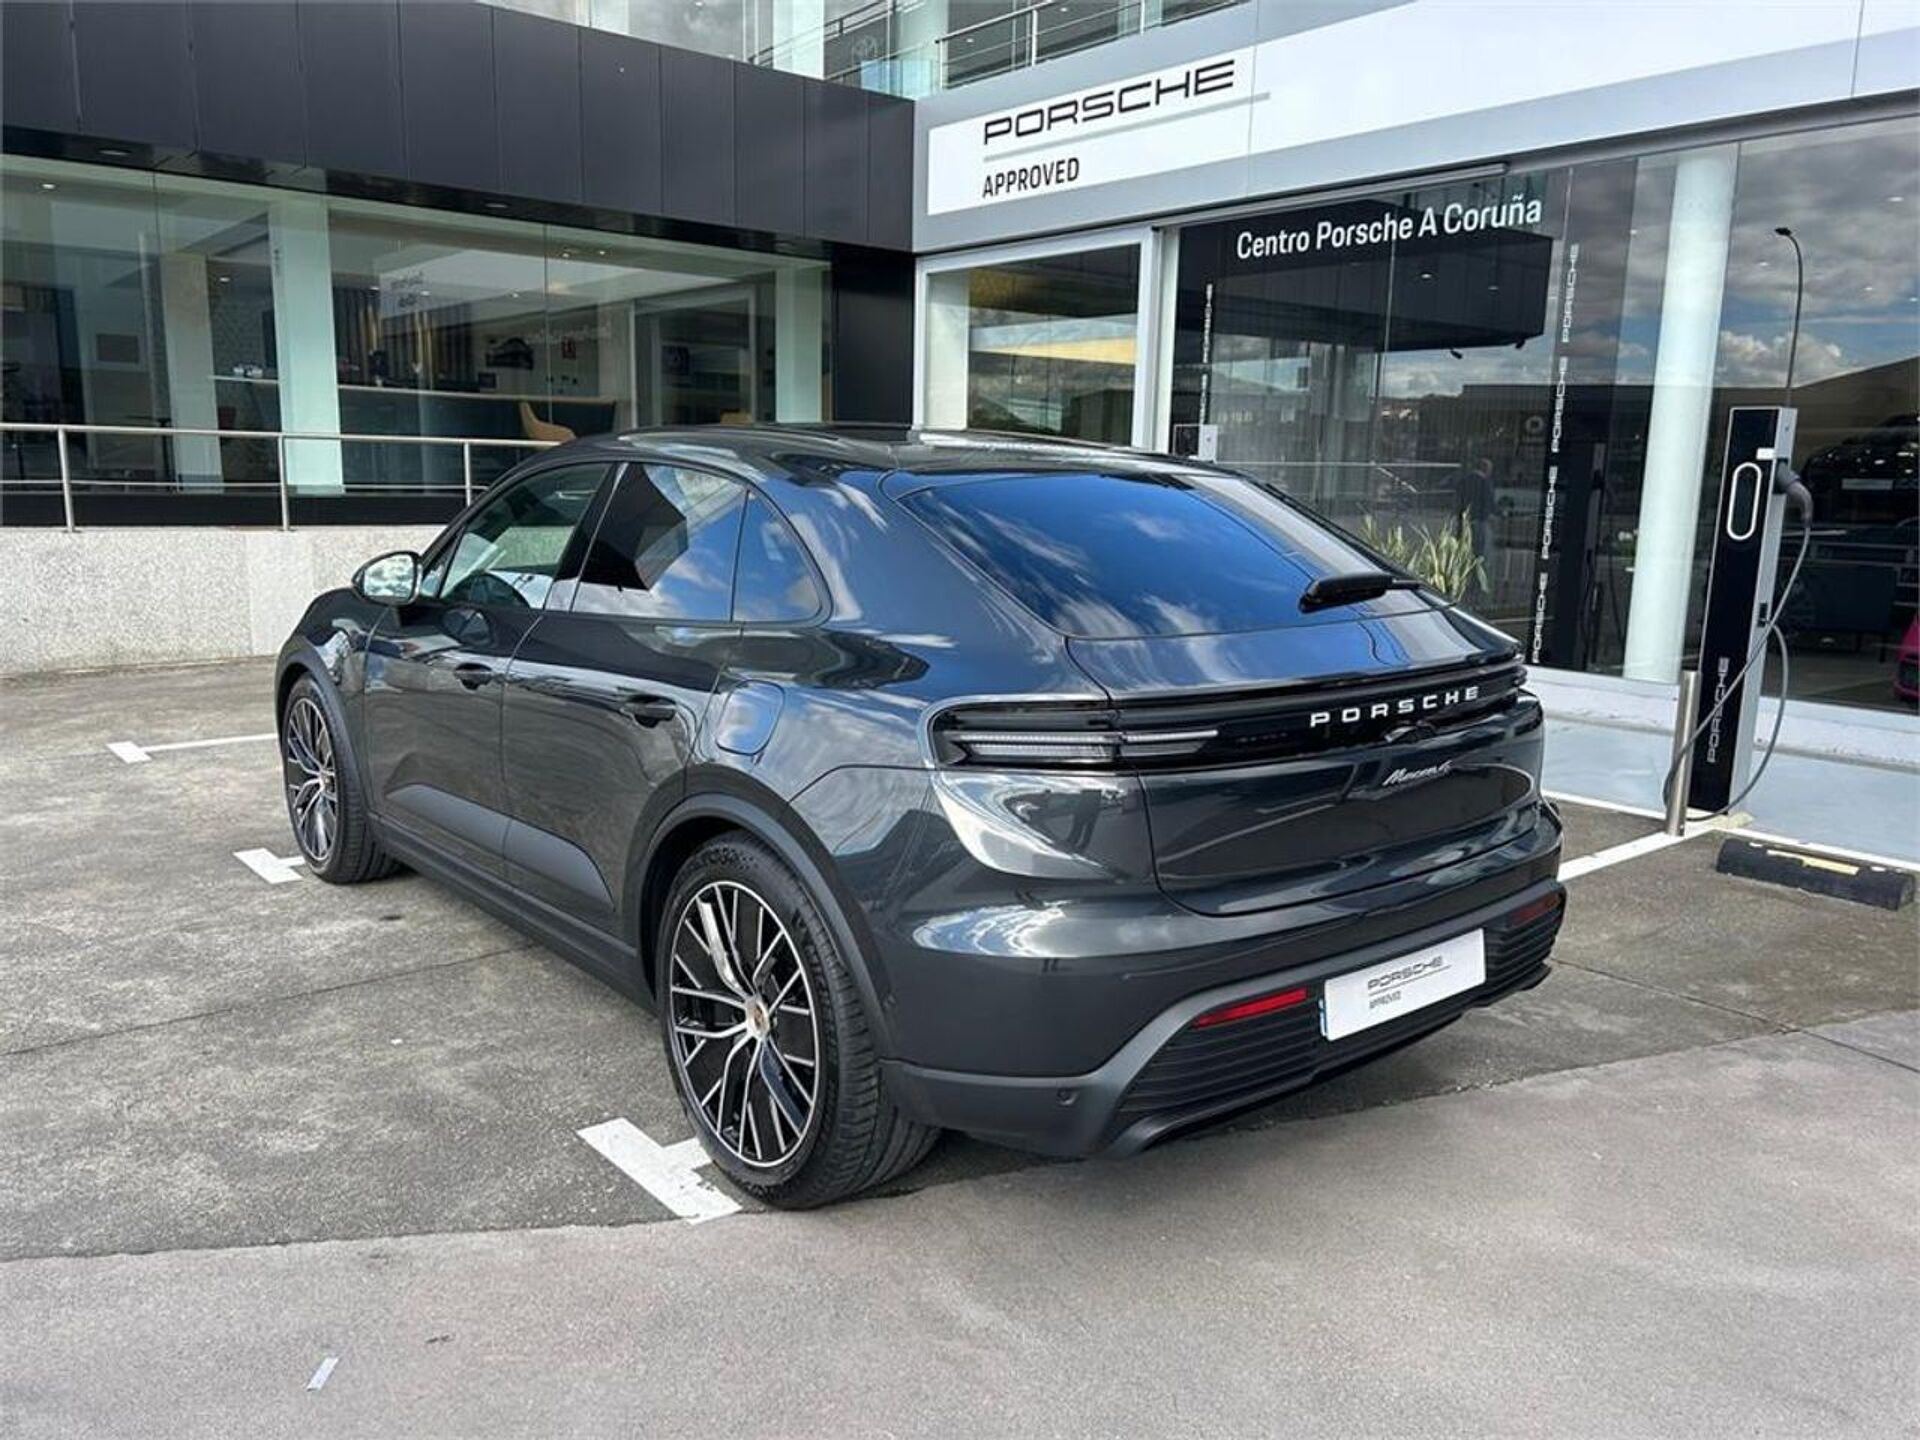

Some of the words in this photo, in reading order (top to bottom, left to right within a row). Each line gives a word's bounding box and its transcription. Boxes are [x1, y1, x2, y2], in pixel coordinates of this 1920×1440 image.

[983, 59, 1235, 145] PORSCHE
[982, 156, 1080, 198] APPROVED
[1236, 229, 1310, 260] Centro
[1315, 211, 1413, 250] Porsche
[1418, 206, 1438, 237] A
[1443, 193, 1542, 235] Coruña
[1562, 244, 1580, 343] PORSCHE
[1551, 356, 1569, 453] PORSCHE
[1541, 465, 1559, 560] PORSCHE
[1531, 572, 1549, 664] PORSCHE
[1309, 686, 1480, 728] PORSCHE
[1367, 955, 1443, 991] PORSCHE
